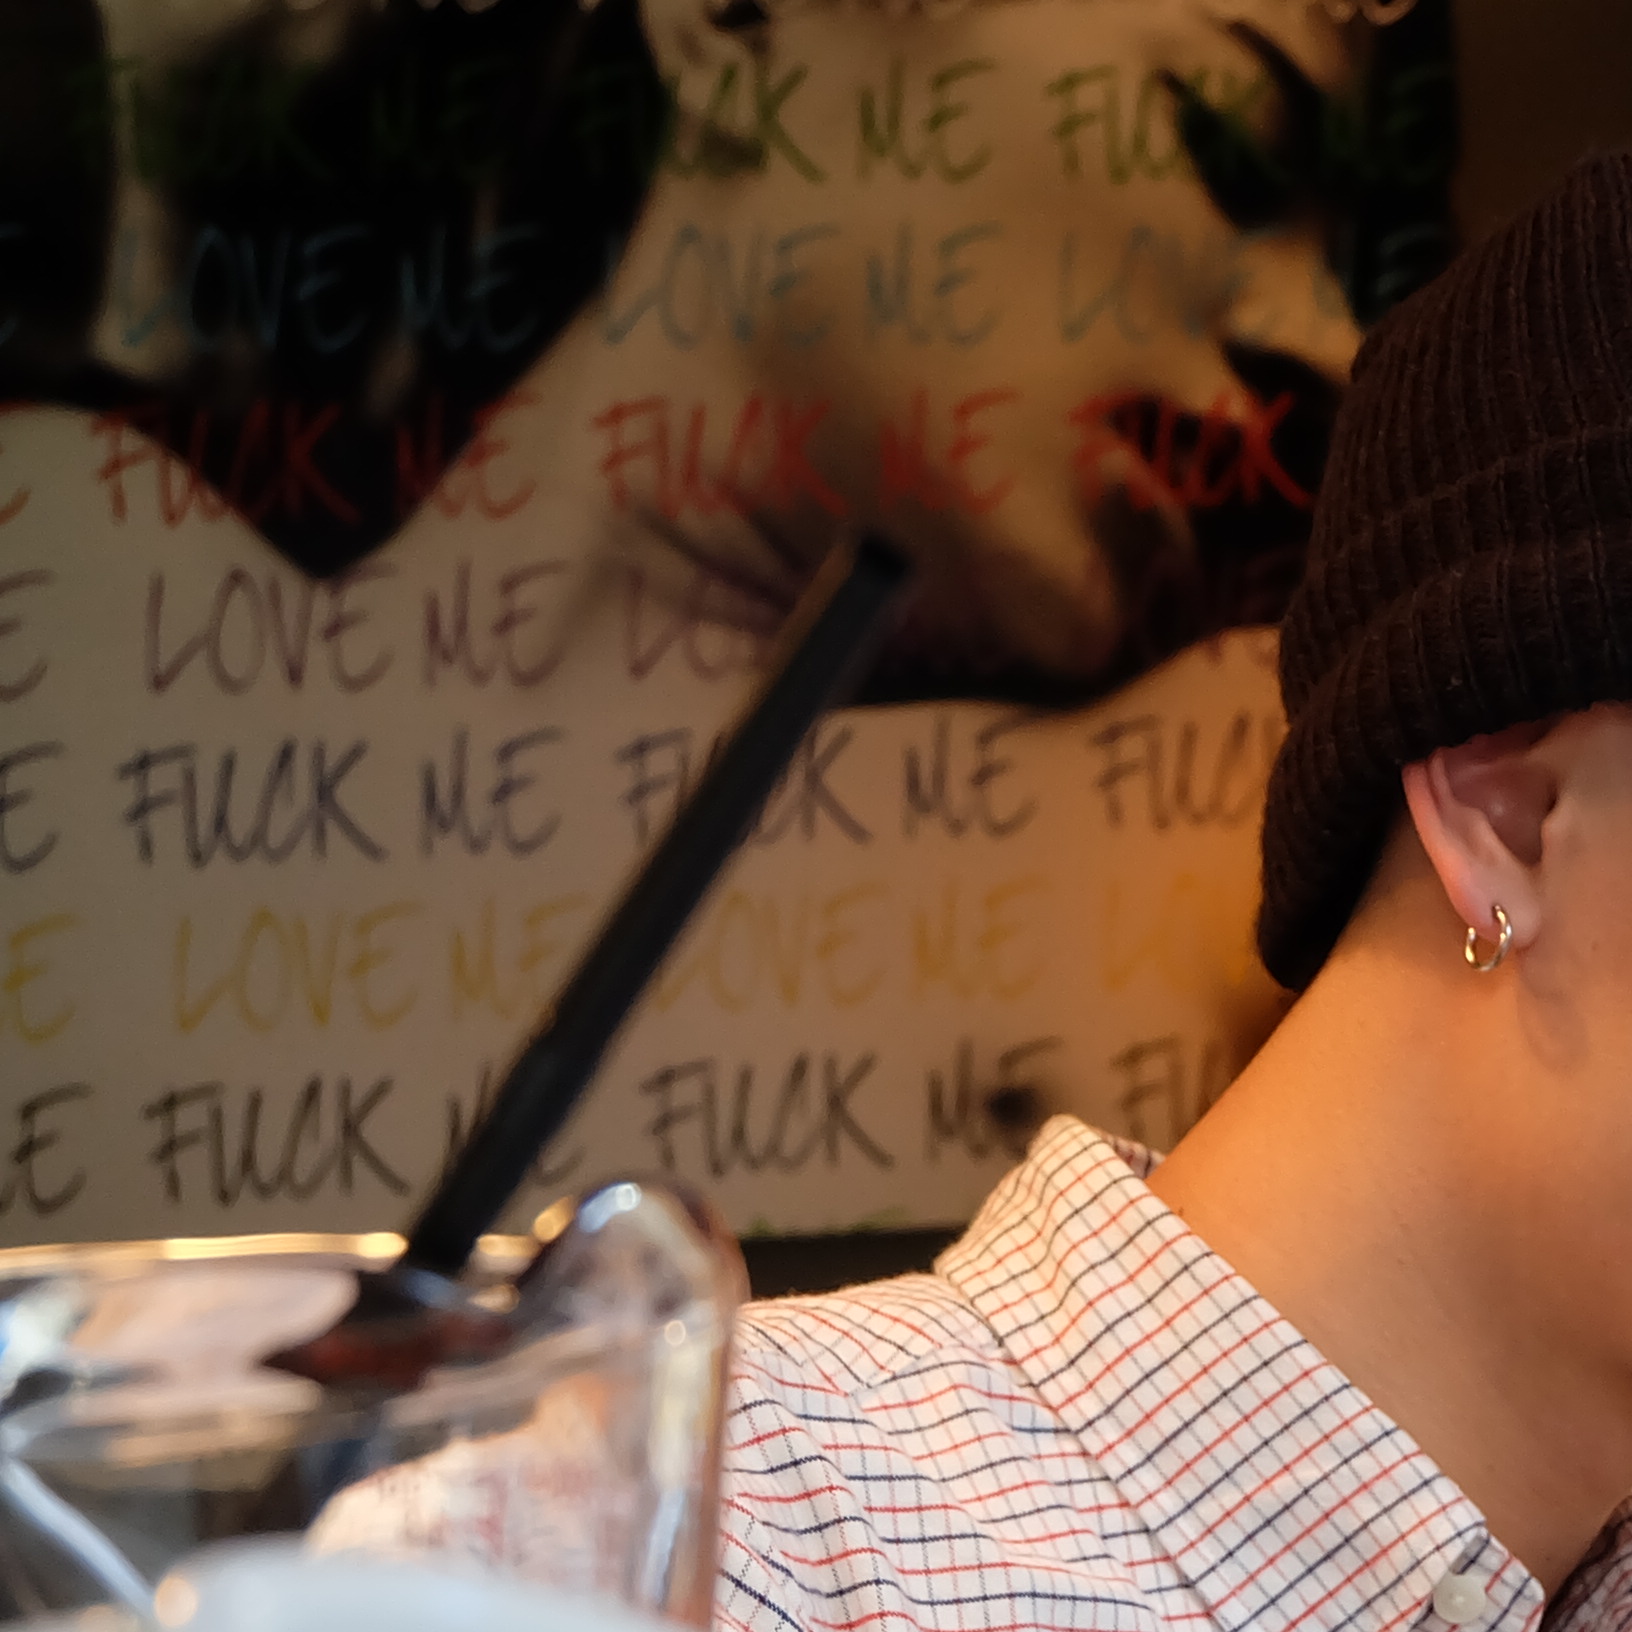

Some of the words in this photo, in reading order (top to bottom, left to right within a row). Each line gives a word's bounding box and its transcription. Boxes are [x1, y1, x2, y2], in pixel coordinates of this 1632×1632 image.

[853, 56, 996, 184] ME
[396, 220, 552, 354] ME
[860, 220, 1002, 346] ME
[92, 398, 362, 528] FUCK
[397, 392, 538, 518] ME
[593, 392, 848, 517] FUCK
[878, 386, 1018, 512] ME
[145, 564, 397, 694] LOVE
[422, 555, 566, 688] ME
[116, 733, 388, 869] FUCK
[418, 724, 563, 859] ME
[900, 715, 1040, 840] ME
[1088, 708, 1284, 834] FUC
[170, 897, 424, 1036] LOVE
[655, 880, 891, 1015] OVE
[908, 870, 1050, 1000] ME
[139, 1070, 411, 1208] FUCK
[638, 1047, 896, 1179] FUCK
